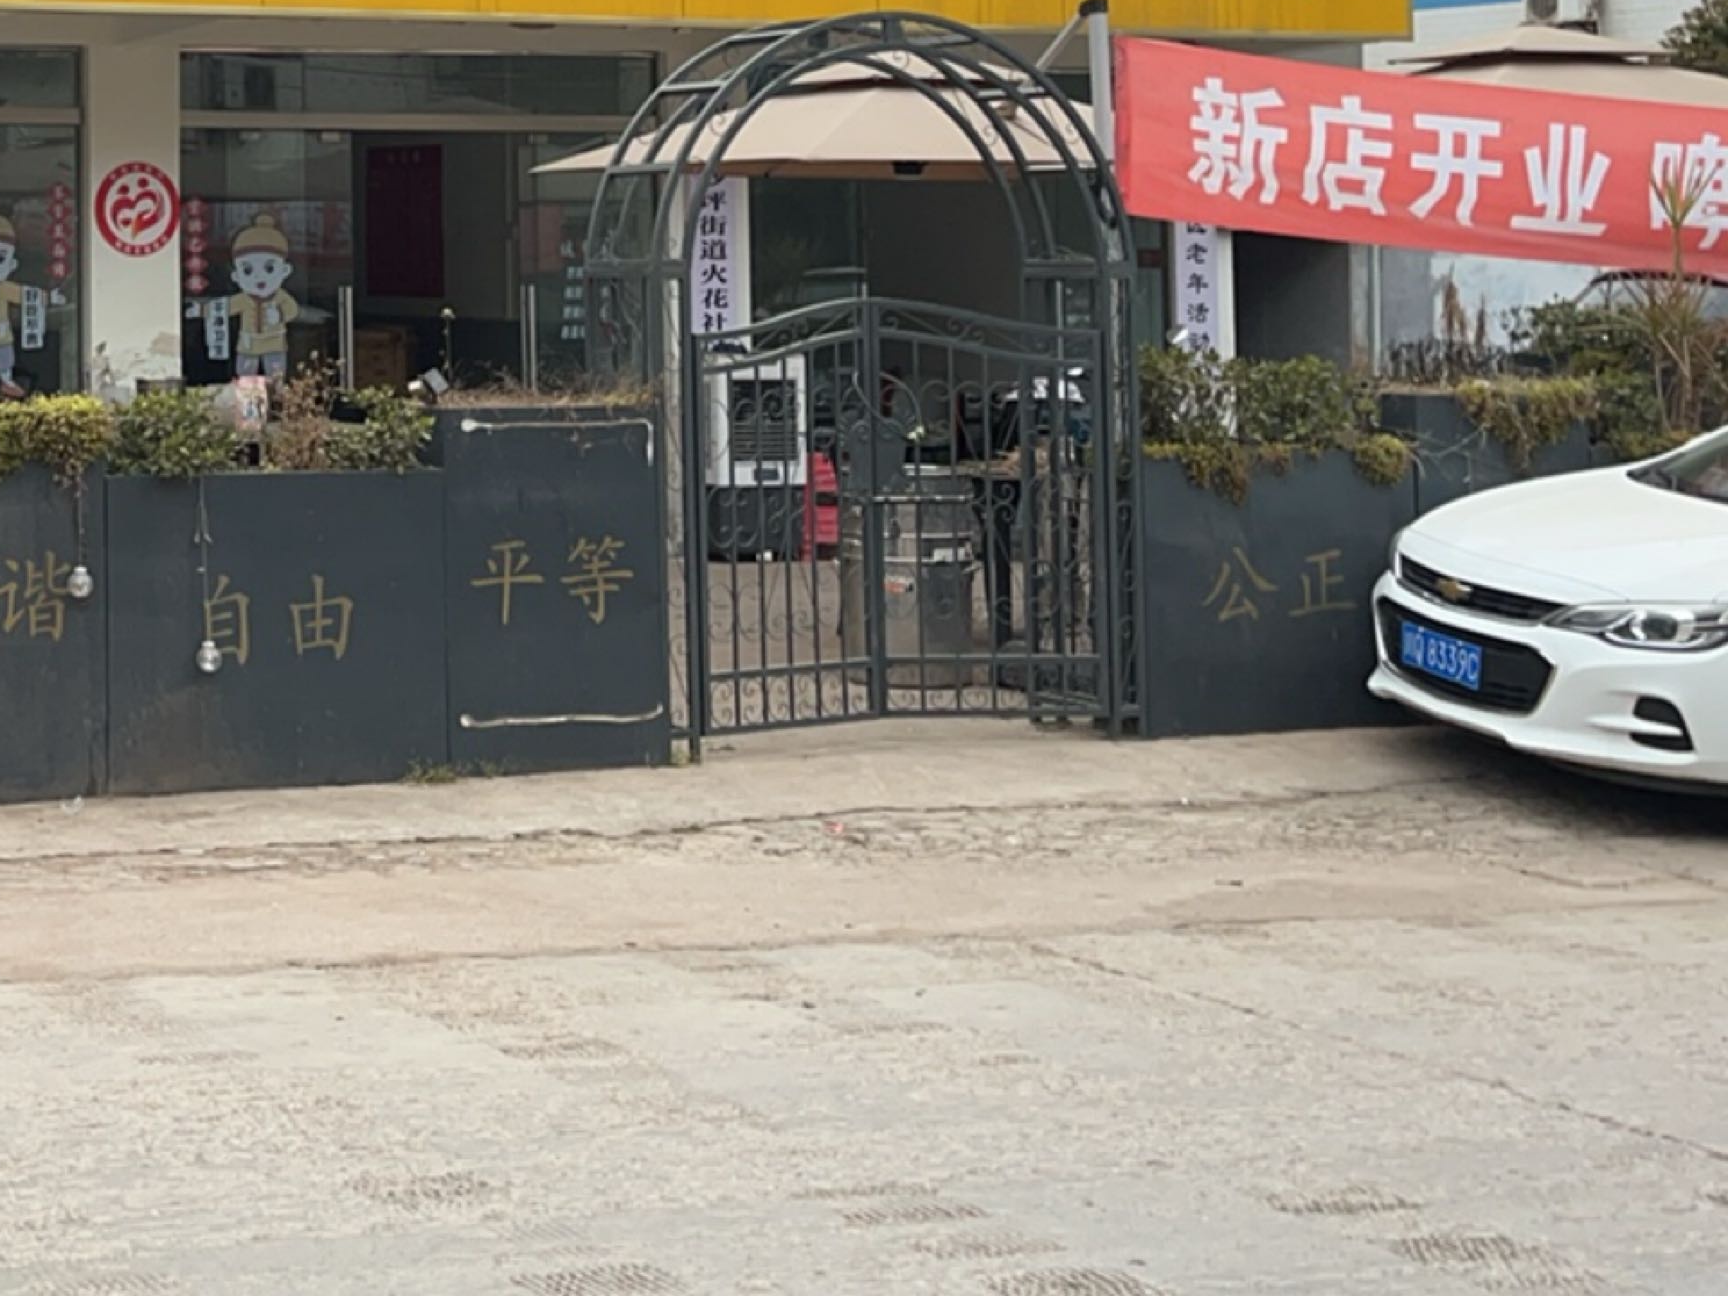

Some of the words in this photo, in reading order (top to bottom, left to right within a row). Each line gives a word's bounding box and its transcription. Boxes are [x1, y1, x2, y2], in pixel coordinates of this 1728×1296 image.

[1187, 77, 1611, 238] 新店开业
[699, 173, 729, 333] 坪街道火花社
[202, 574, 355, 665] 自由
[471, 534, 634, 625] 平等
[1201, 545, 1359, 623] 公正
